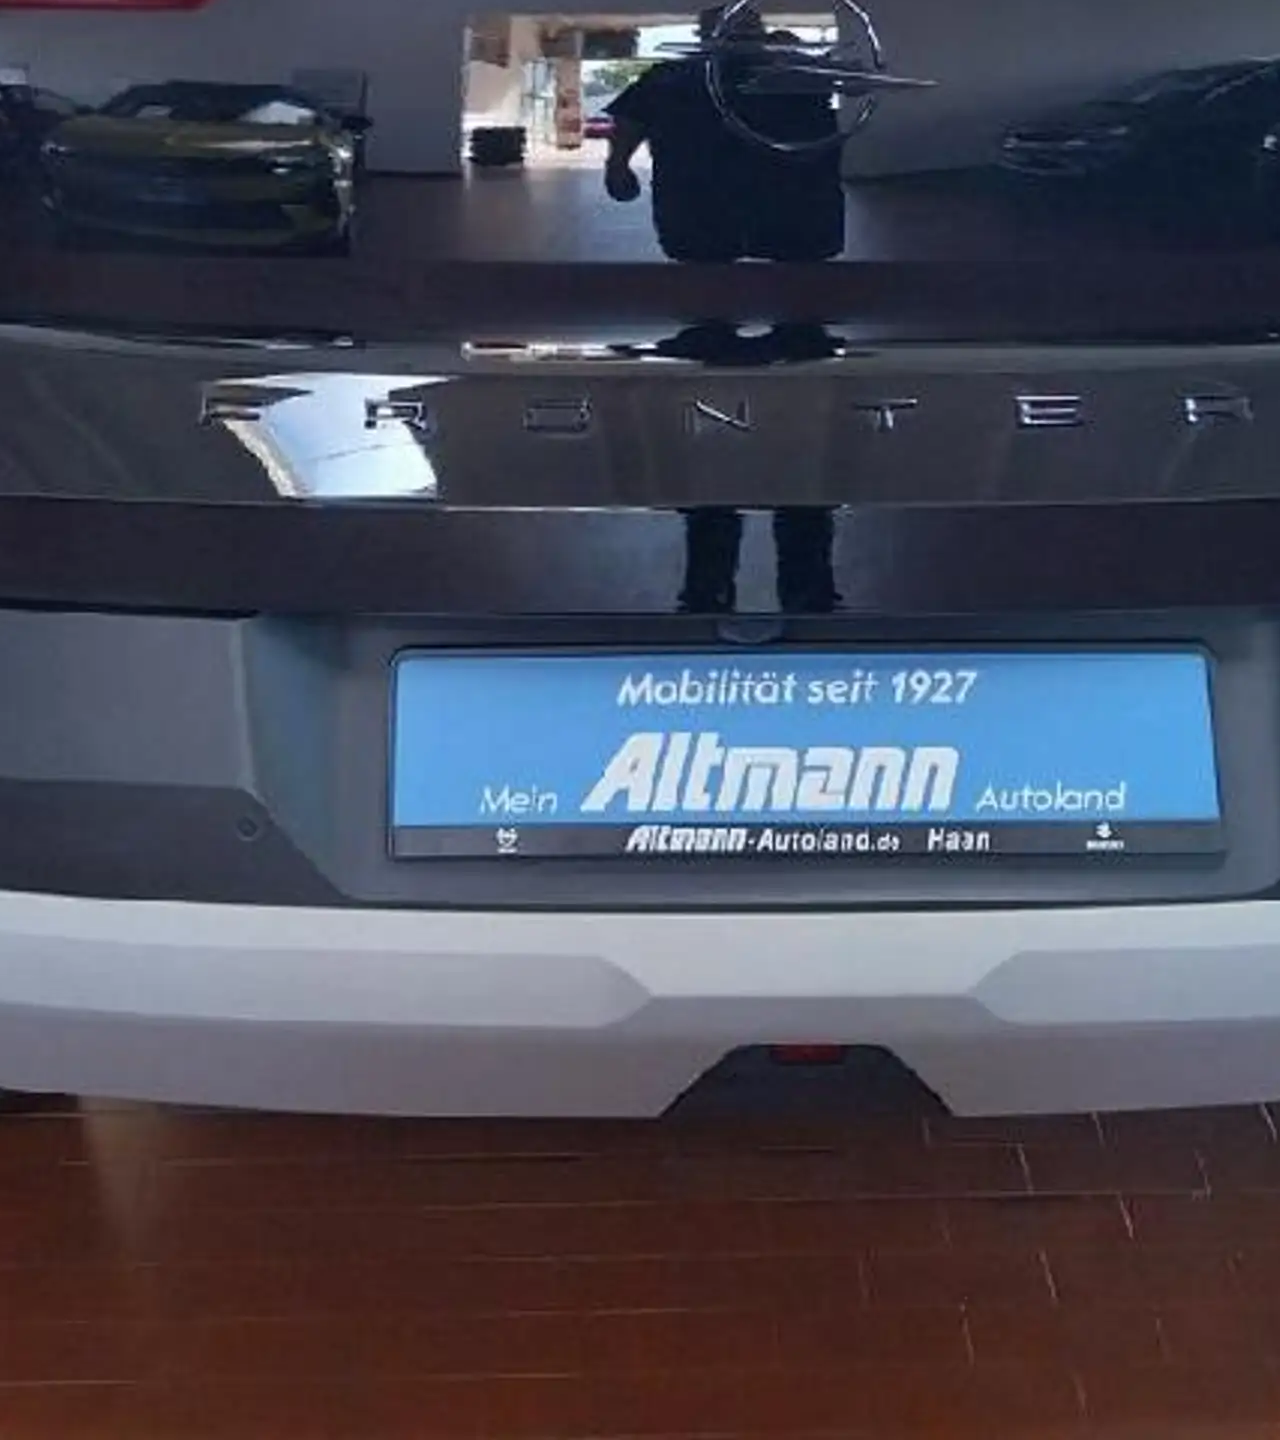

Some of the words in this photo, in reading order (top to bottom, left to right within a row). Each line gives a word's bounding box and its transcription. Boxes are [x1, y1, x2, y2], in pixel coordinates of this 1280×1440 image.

[616, 667, 797, 706] Mobilität
[807, 668, 879, 704] seit
[890, 670, 979, 704] 1927
[480, 785, 558, 814] Mein
[579, 731, 960, 812] Altmann
[975, 781, 1127, 812] Autoland
[926, 827, 991, 853] Haan
